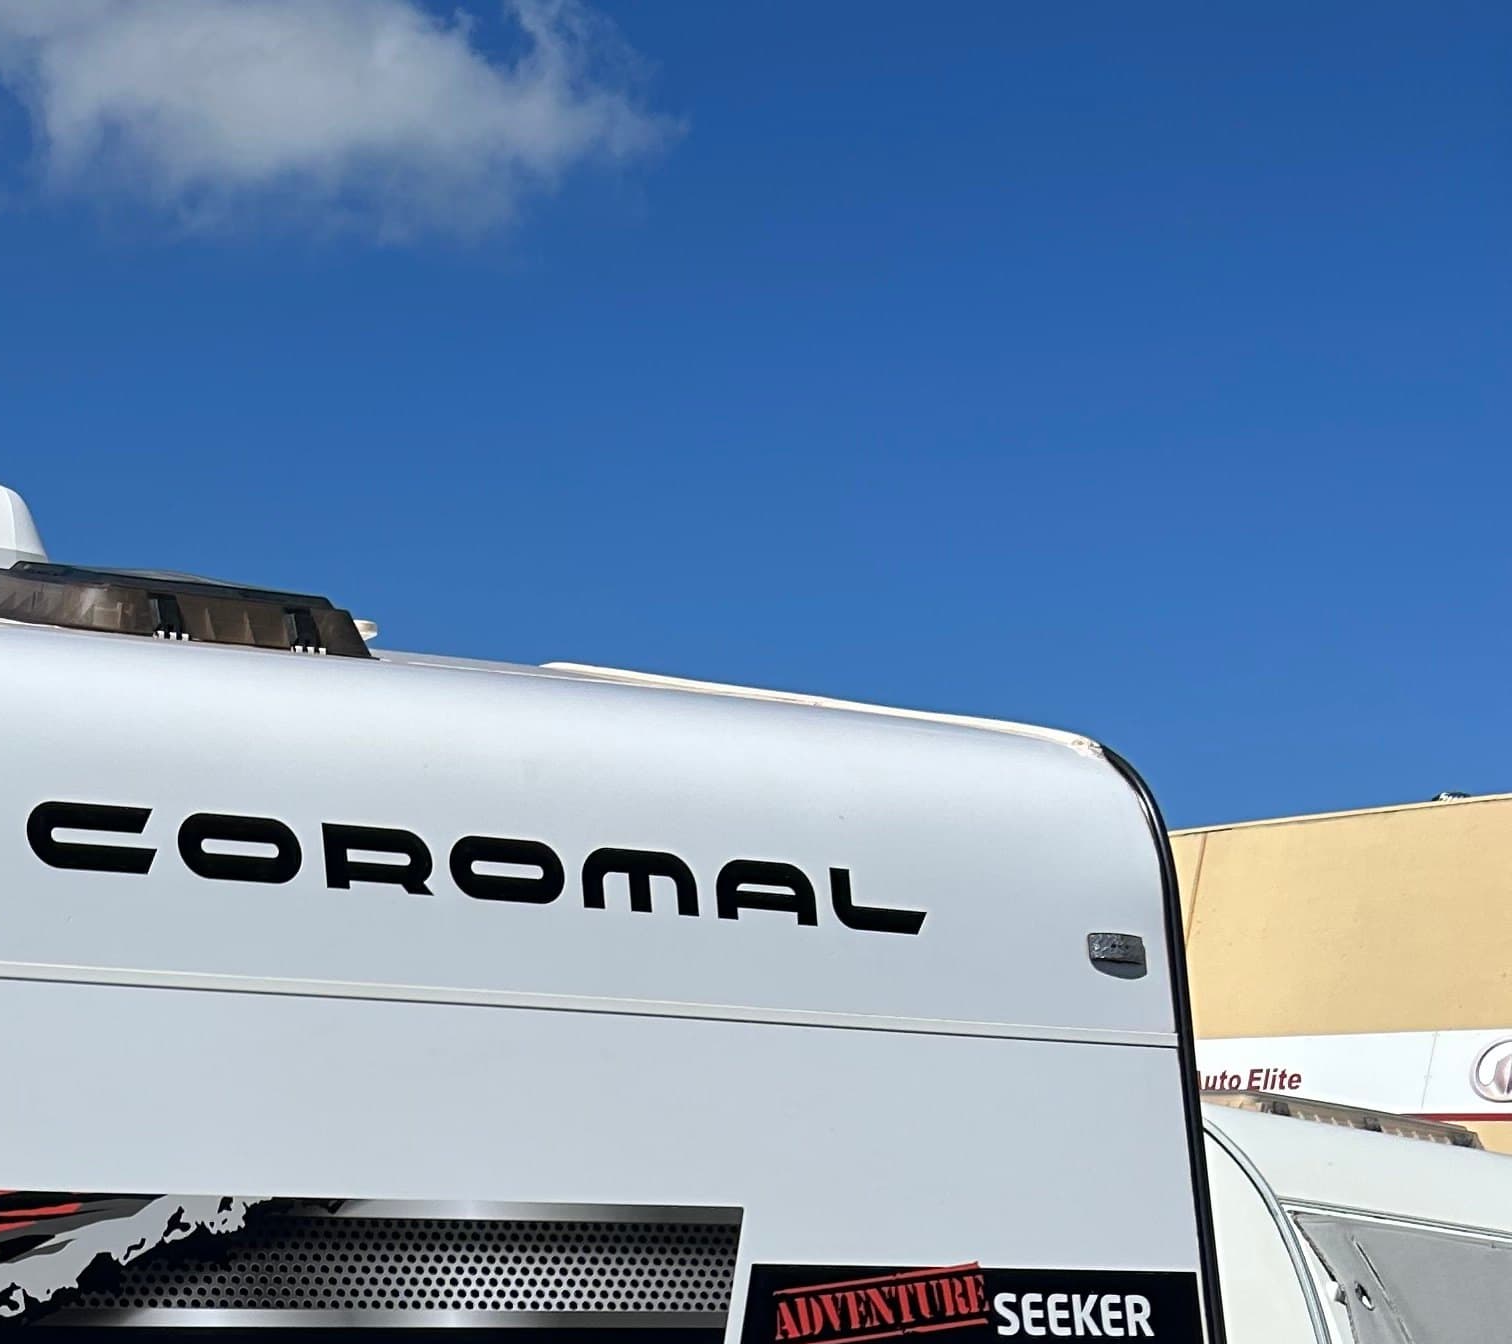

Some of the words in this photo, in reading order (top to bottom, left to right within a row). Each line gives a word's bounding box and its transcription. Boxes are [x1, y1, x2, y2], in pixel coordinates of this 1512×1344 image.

[26, 799, 928, 936] COROMAL
[1248, 1067, 1302, 1091] Elite
[774, 1274, 989, 1341] ADVENTURE
[993, 1291, 1156, 1338] SEEKER
